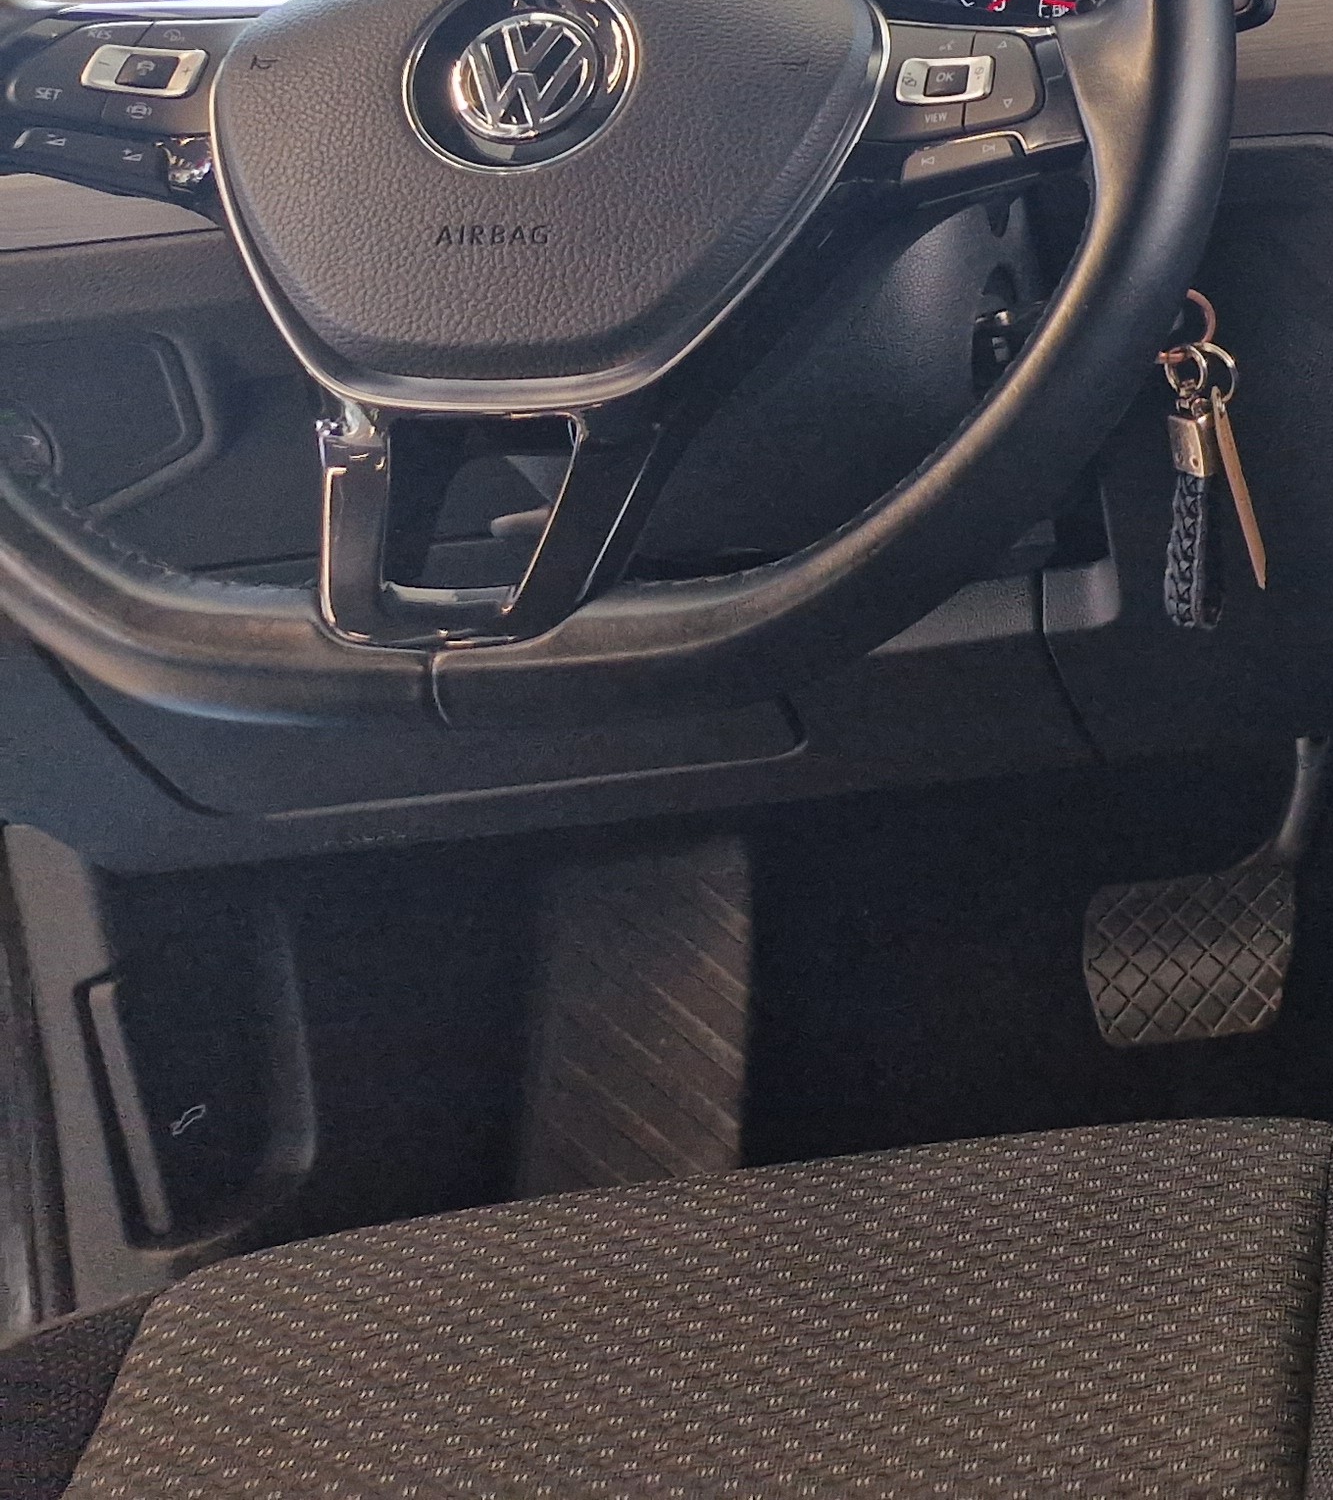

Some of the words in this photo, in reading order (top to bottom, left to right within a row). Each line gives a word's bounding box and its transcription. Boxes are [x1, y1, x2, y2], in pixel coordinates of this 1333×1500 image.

[87, 28, 113, 41] RES
[935, 70, 955, 84] OK
[34, 86, 63, 102] SET
[924, 111, 949, 124] VIEW
[434, 224, 550, 247] AIRBAG
